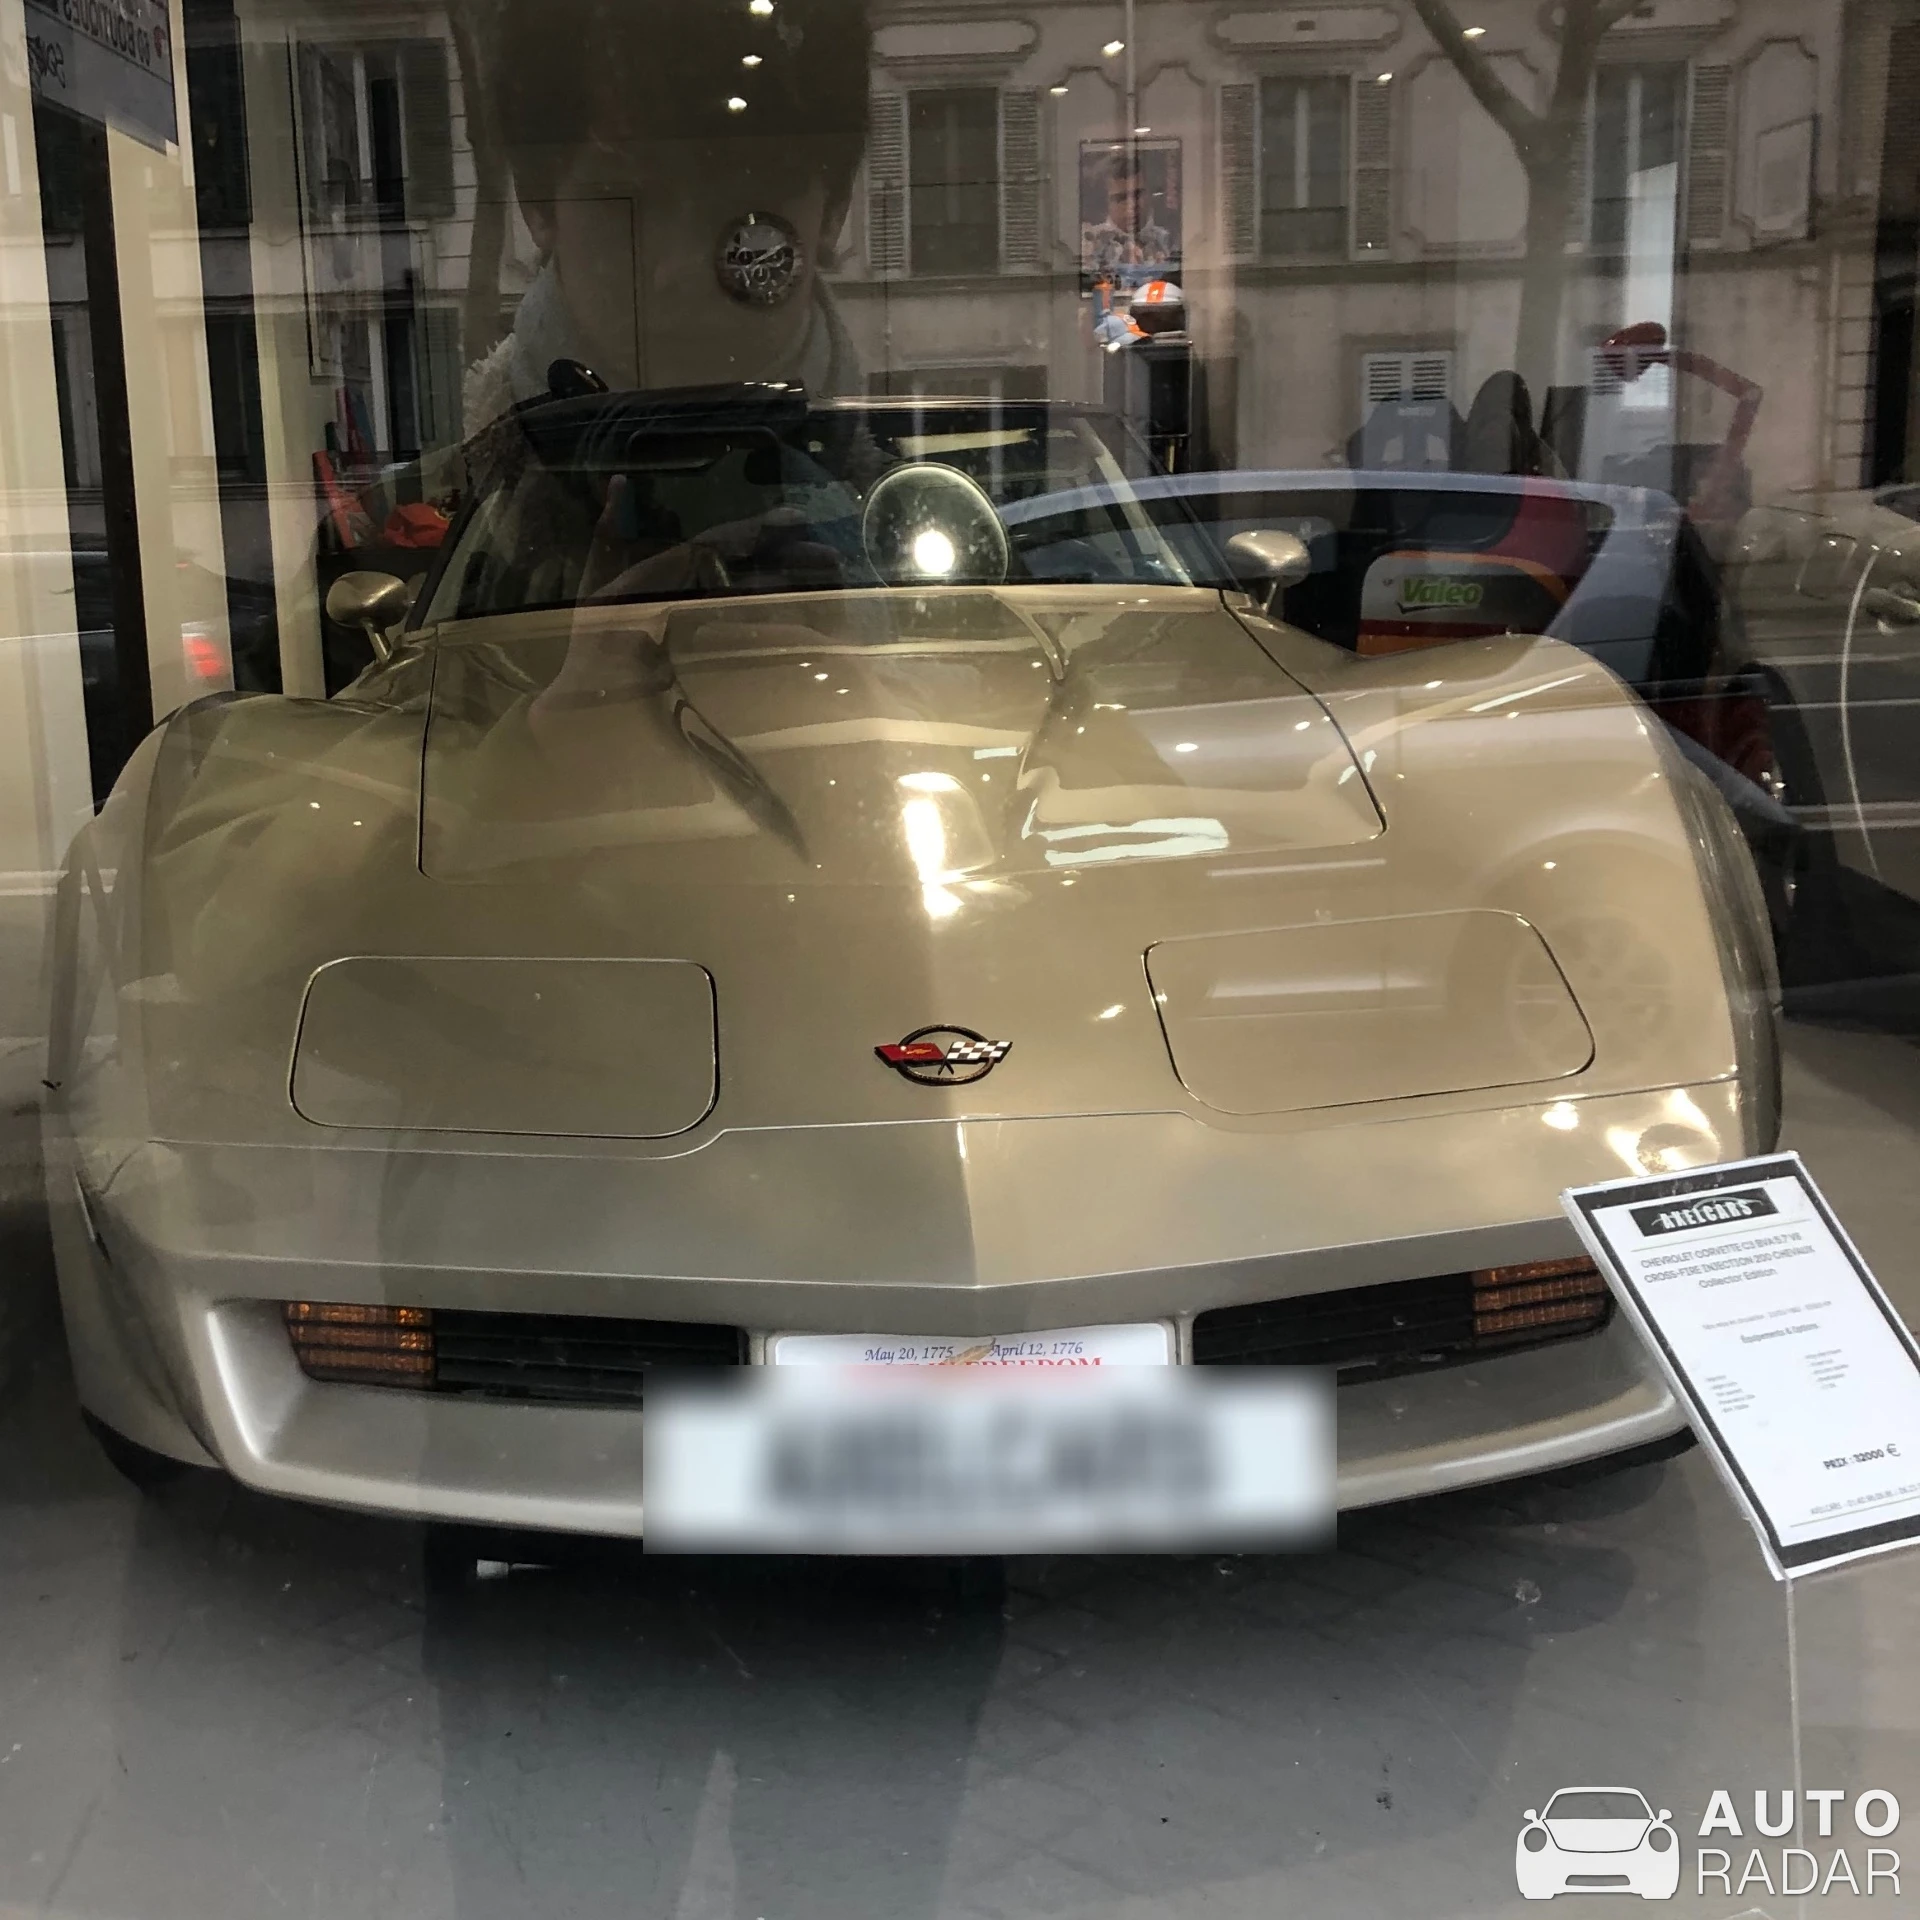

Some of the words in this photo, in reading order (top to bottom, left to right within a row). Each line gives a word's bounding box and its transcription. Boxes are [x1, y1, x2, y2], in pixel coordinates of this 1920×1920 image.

[1402, 577, 1483, 604] Valeo
[1659, 1200, 1753, 1230] AXELCARS
[1641, 1251, 1695, 1269] CHEVROLET
[1694, 1243, 1743, 1259] CORVETTE
[1644, 1264, 1701, 1283] CROSS-FIRE
[1702, 1255, 1754, 1275] INJECTION
[1699, 1273, 1743, 1289] Collector
[1743, 1267, 1778, 1281] Edition
[865, 1347, 894, 1363] May
[899, 1347, 918, 1361] 20,
[921, 1345, 954, 1359] 1775
[991, 1341, 1026, 1361] April
[1027, 1341, 1048, 1357] 12,
[1051, 1341, 1084, 1355] 1776
